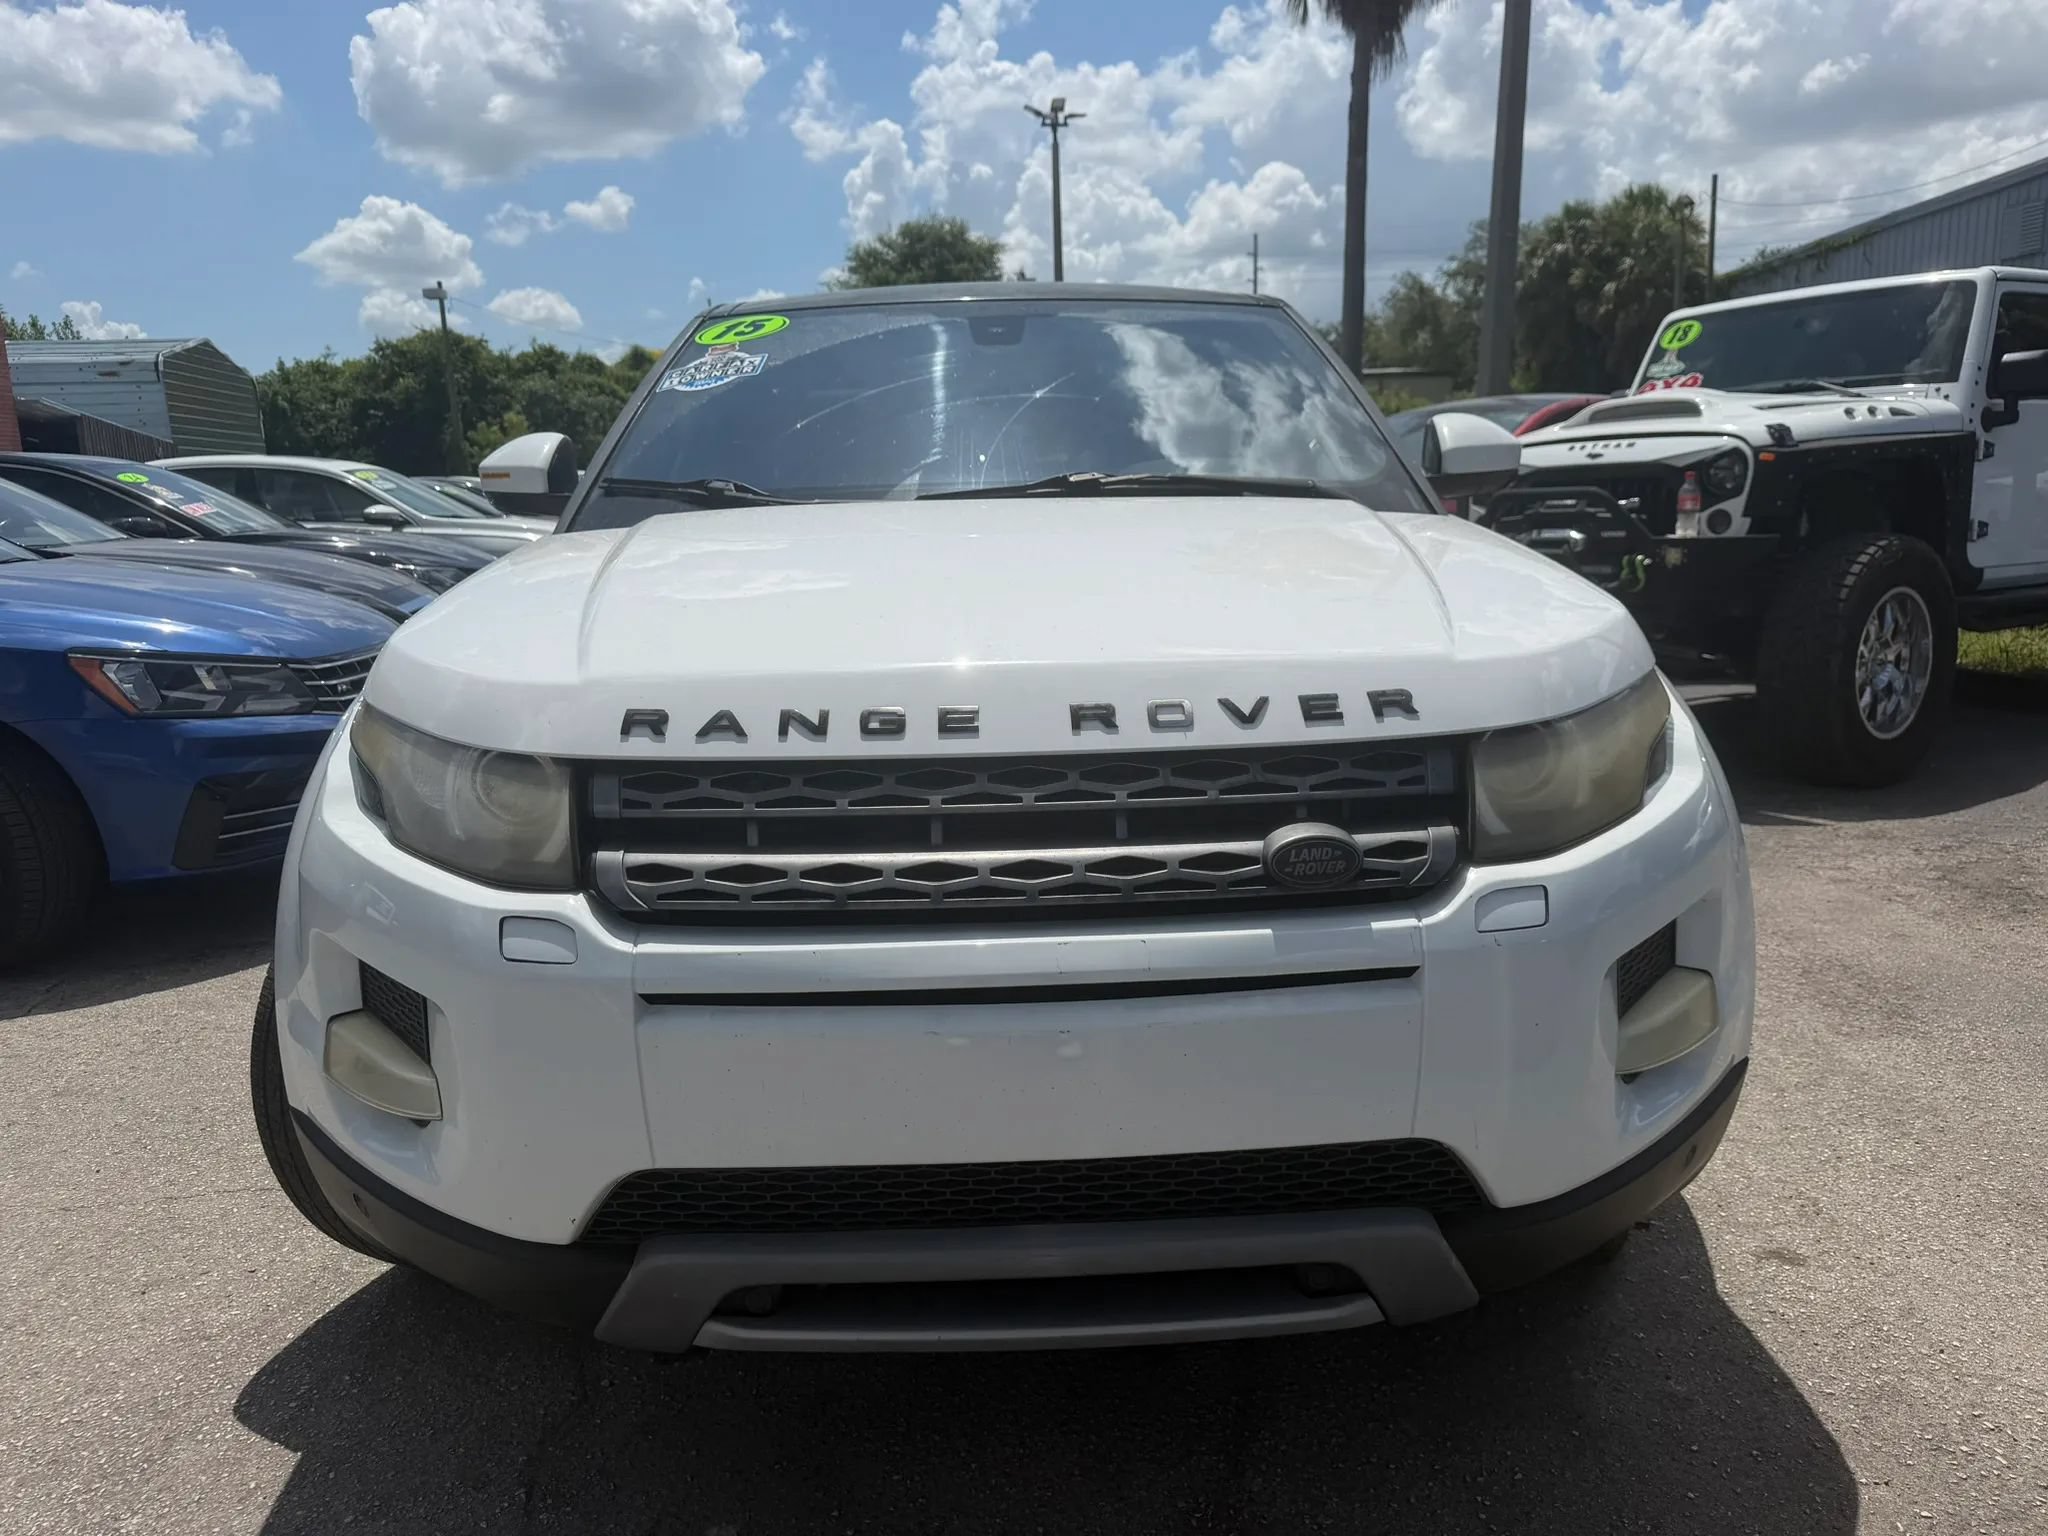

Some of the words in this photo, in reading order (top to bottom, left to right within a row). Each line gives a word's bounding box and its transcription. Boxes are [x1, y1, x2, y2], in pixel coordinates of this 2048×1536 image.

[711, 318, 774, 340] 15
[672, 358, 760, 378] CARFAX
[620, 705, 980, 737] RANGE
[1069, 688, 1420, 731] ROVER
[1289, 847, 1332, 862] LAND
[1294, 861, 1346, 876] ROVER
